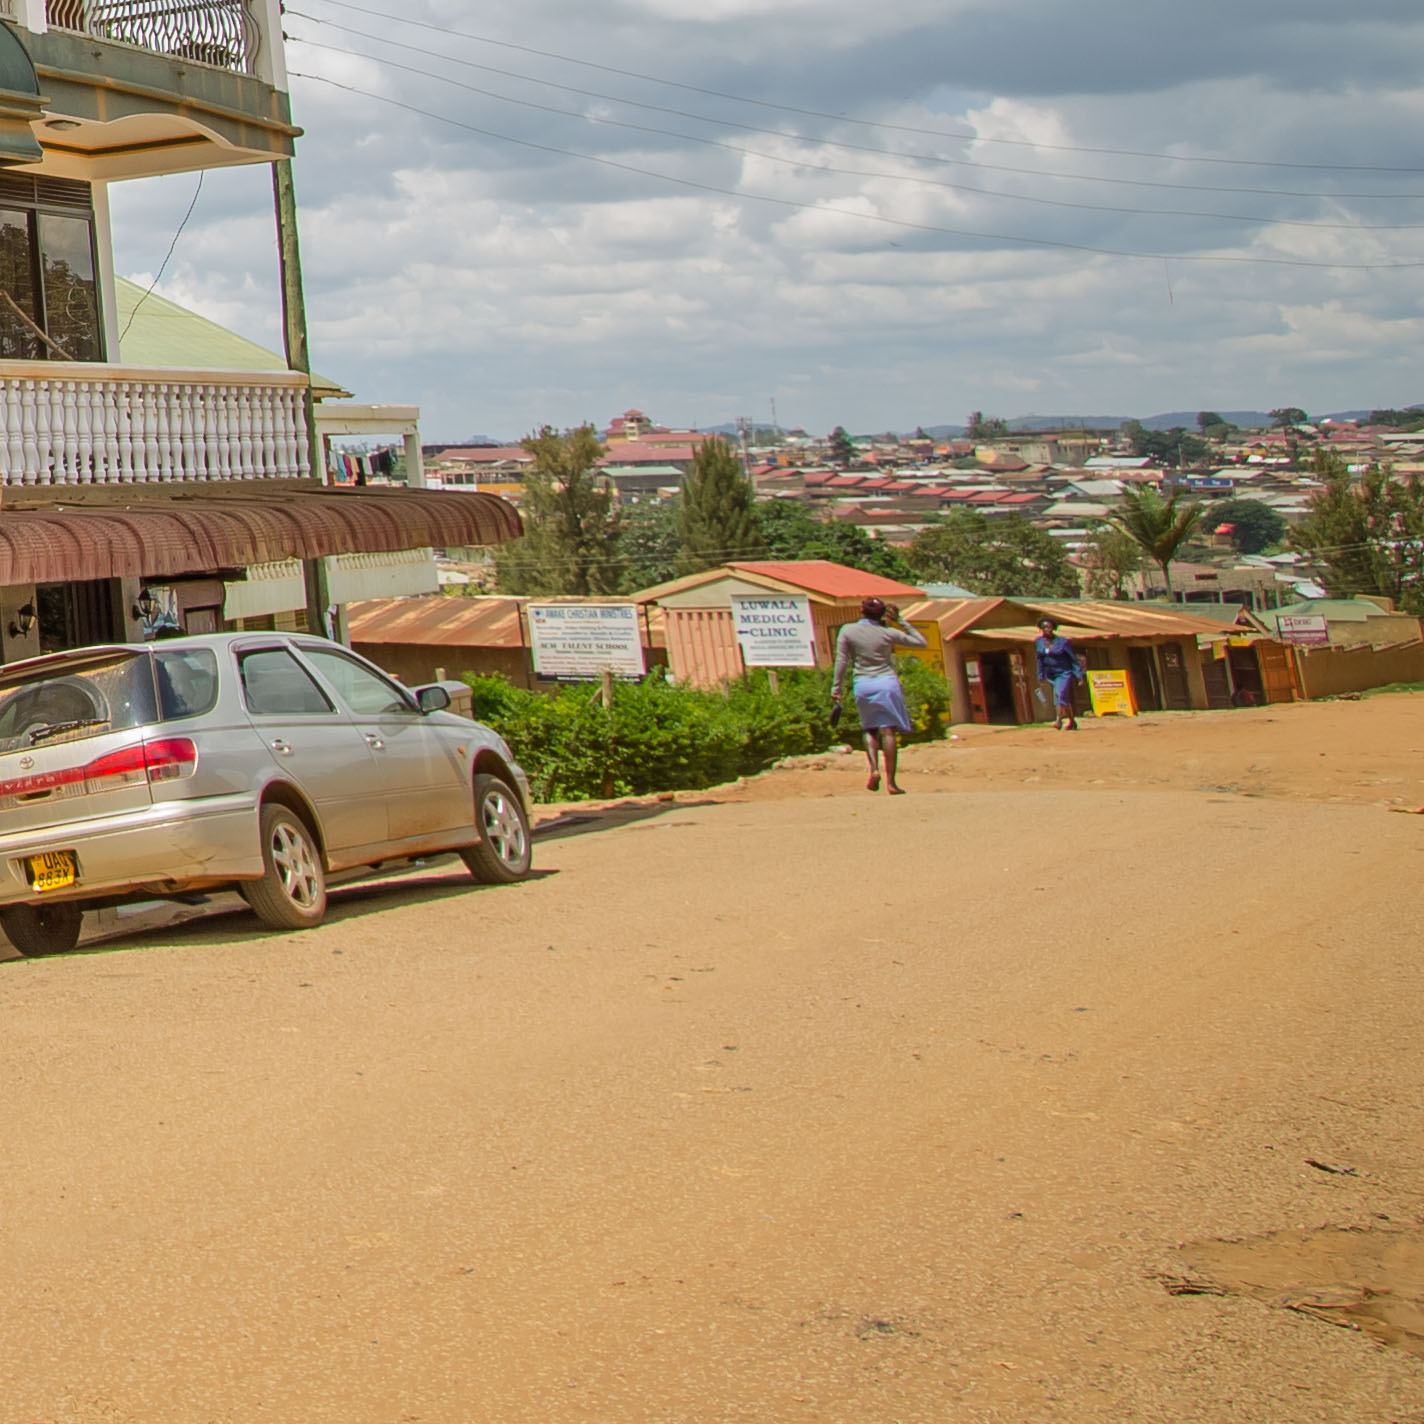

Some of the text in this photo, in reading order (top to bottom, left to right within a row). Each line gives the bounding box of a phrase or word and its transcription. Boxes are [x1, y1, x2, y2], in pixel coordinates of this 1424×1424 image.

[740, 599, 798, 611] LUWALA
[740, 614, 805, 624] MEDICAL
[750, 627, 798, 637] CLINIC
[562, 642, 593, 650] TALENT
[595, 643, 629, 651] SCHOOL
